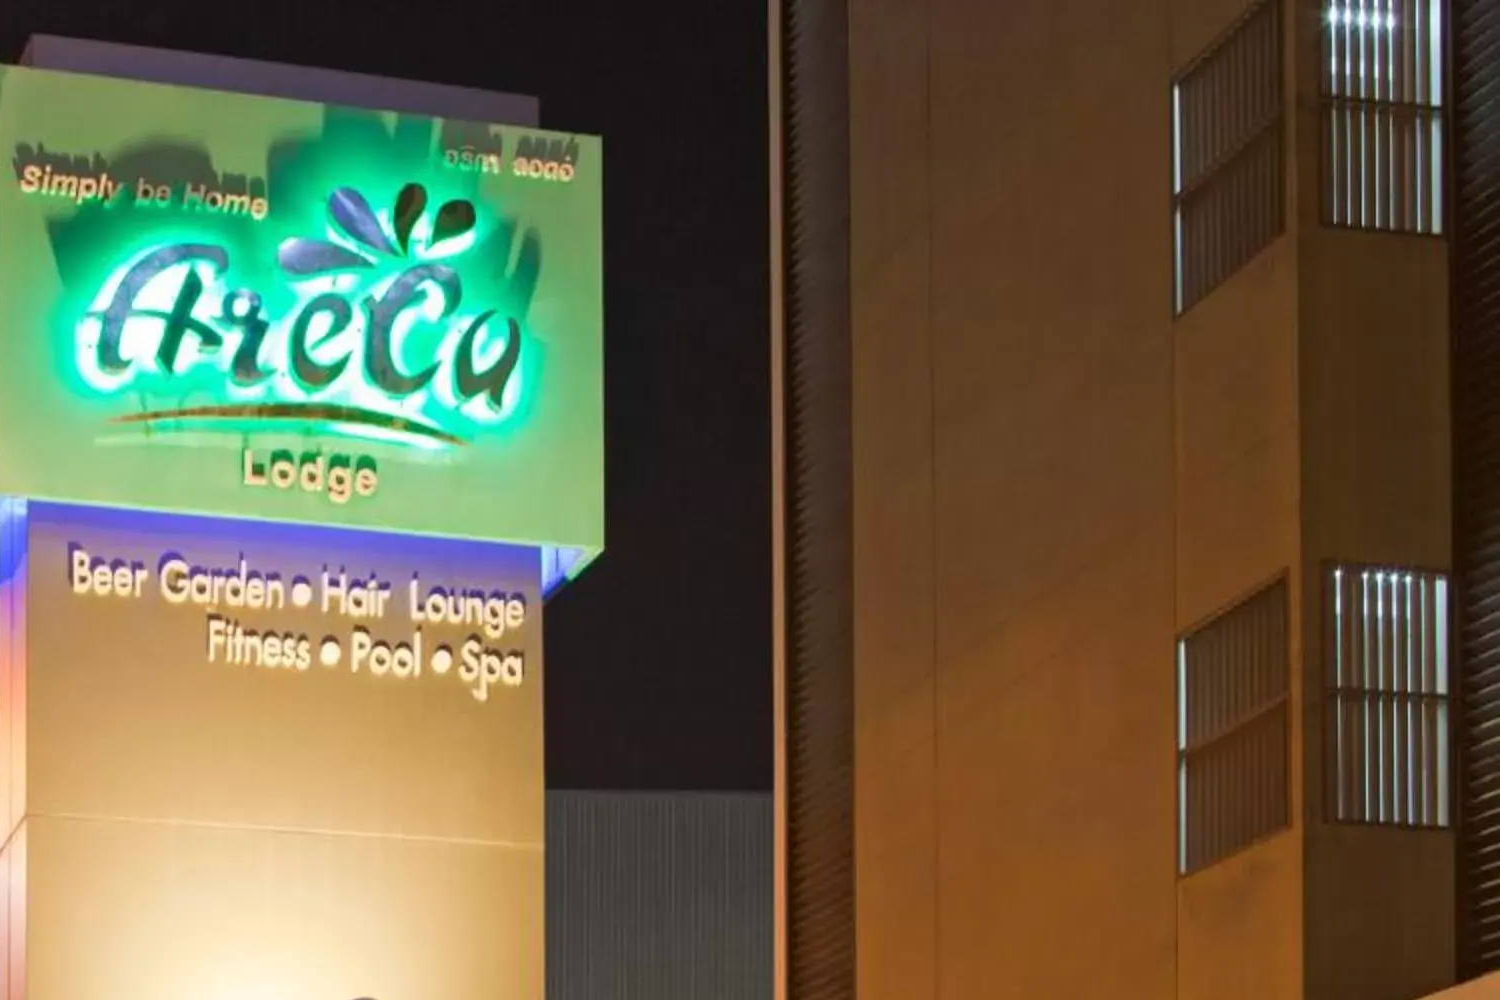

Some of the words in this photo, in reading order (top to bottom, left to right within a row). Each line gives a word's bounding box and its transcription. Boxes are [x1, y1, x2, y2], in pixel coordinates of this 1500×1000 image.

[20, 163, 123, 209] Simply
[135, 177, 171, 208] be
[182, 182, 269, 221] Home
[80, 242, 521, 412] Areca
[243, 448, 380, 504] Lodge
[71, 549, 148, 598] Beer
[159, 556, 285, 610] Garden
[320, 570, 391, 618] Hair
[410, 578, 525, 638] Lounge
[207, 618, 311, 670] Fitness
[351, 629, 422, 678] Pool
[458, 640, 524, 701] Spa
